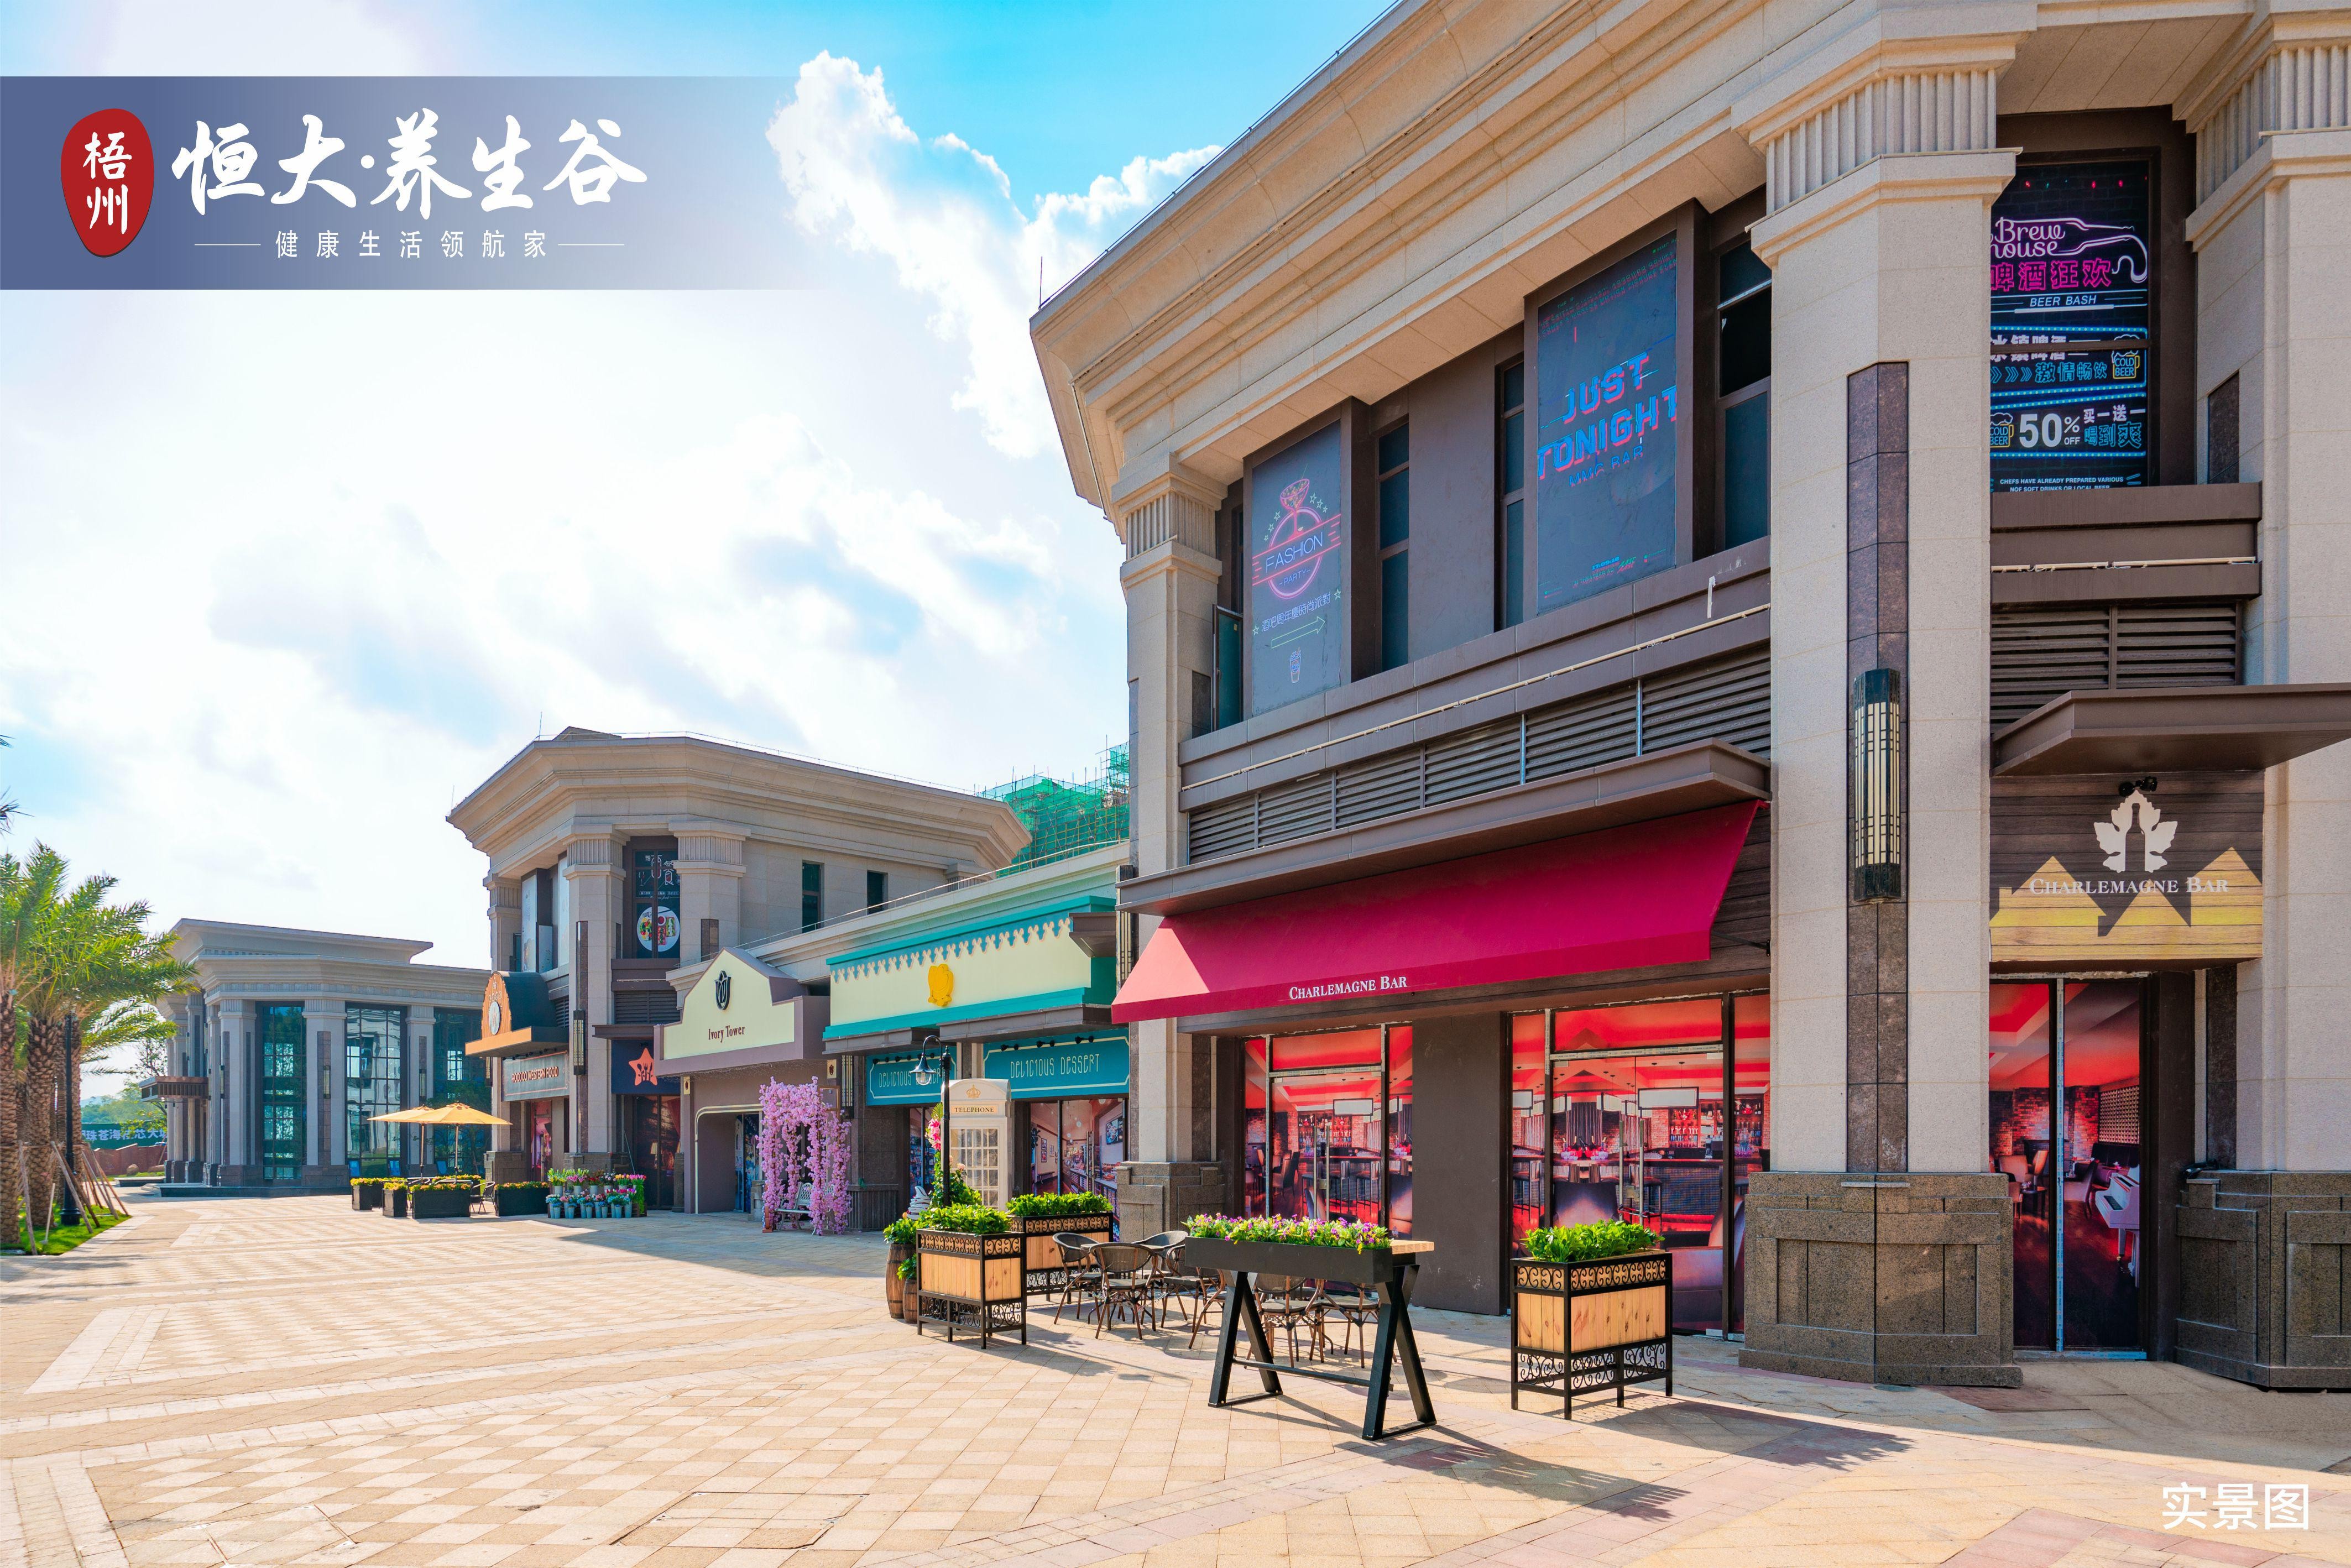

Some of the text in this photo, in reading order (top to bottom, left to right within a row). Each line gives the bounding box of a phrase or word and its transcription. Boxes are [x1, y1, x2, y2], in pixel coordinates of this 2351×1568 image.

[1995, 217, 2065, 243] Brew
[1990, 258, 2111, 291] 啤酒狂欢
[2030, 295, 2097, 307] BEER BASH
[2035, 362, 2107, 383] 激情畅饮
[2114, 358, 2134, 367] COLD
[2115, 368, 2134, 377] BEER
[1562, 351, 1649, 424] JUST
[2083, 404, 2145, 424] 买一送一
[1537, 385, 1676, 479] TONIGHT
[1990, 427, 2008, 436] COLD
[1990, 436, 2008, 445] BEER
[2084, 422, 2141, 449] 喝到爽
[1266, 531, 1323, 573] FASHION
[2029, 877, 2229, 894] CHARLEMAGNE BAR
[1289, 976, 1407, 1000] CHARLEMAGNE BAR
[708, 1025, 745, 1043] Ivory Tower
[527, 1068, 545, 1080] WESTERN
[546, 1066, 558, 1078] FOOD
[1060, 1053, 1100, 1075] DESSERT
